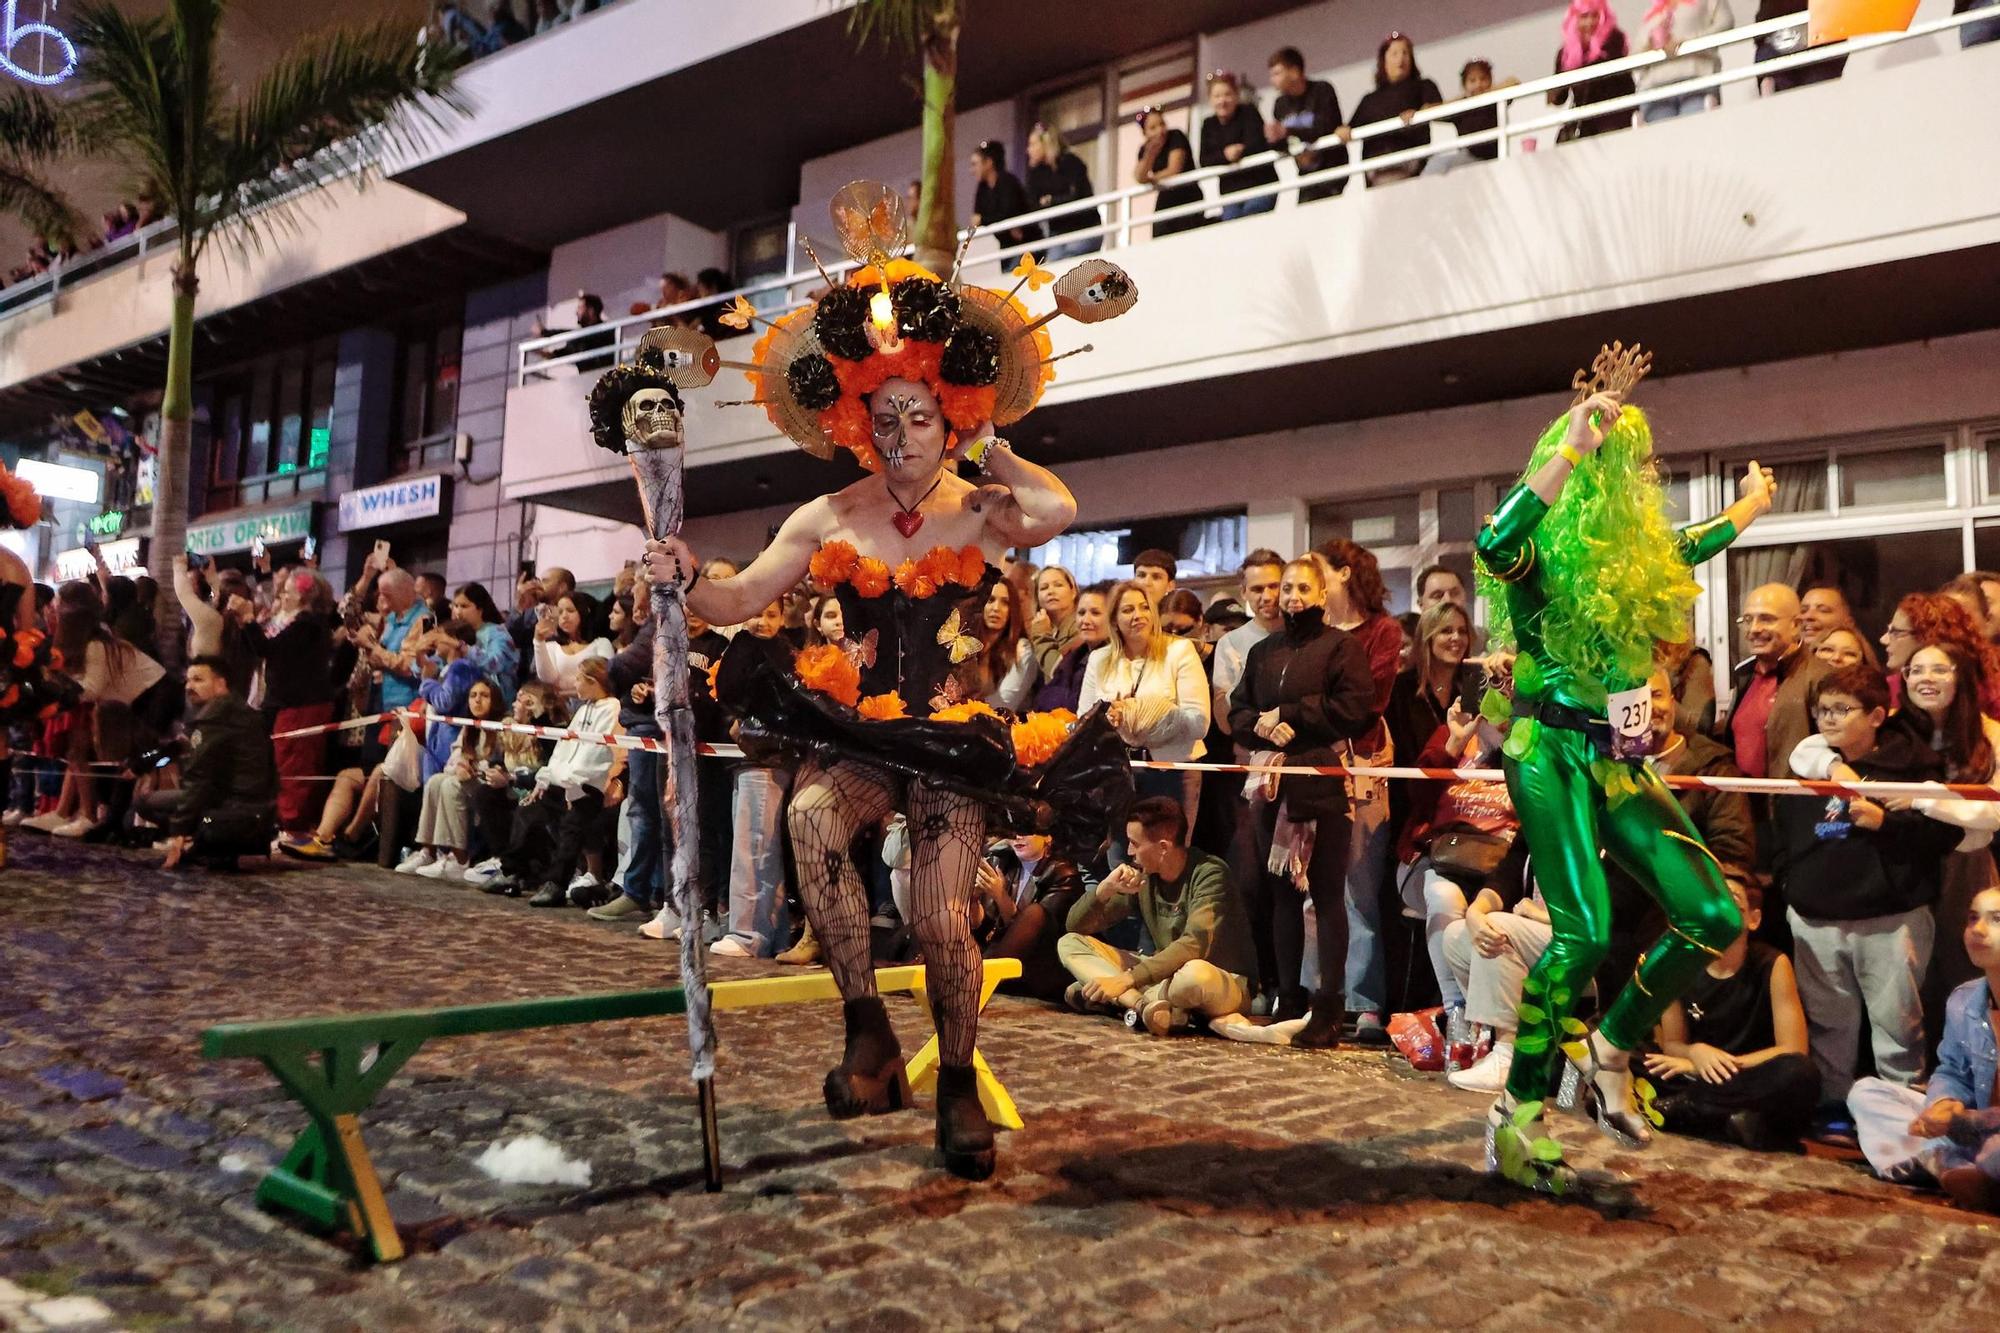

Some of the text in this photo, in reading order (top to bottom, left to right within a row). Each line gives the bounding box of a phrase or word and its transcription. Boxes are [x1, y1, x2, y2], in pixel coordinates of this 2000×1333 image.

[362, 482, 435, 512] WHESH
[185, 526, 225, 552] ORTES
[1622, 700, 1647, 729] 237
